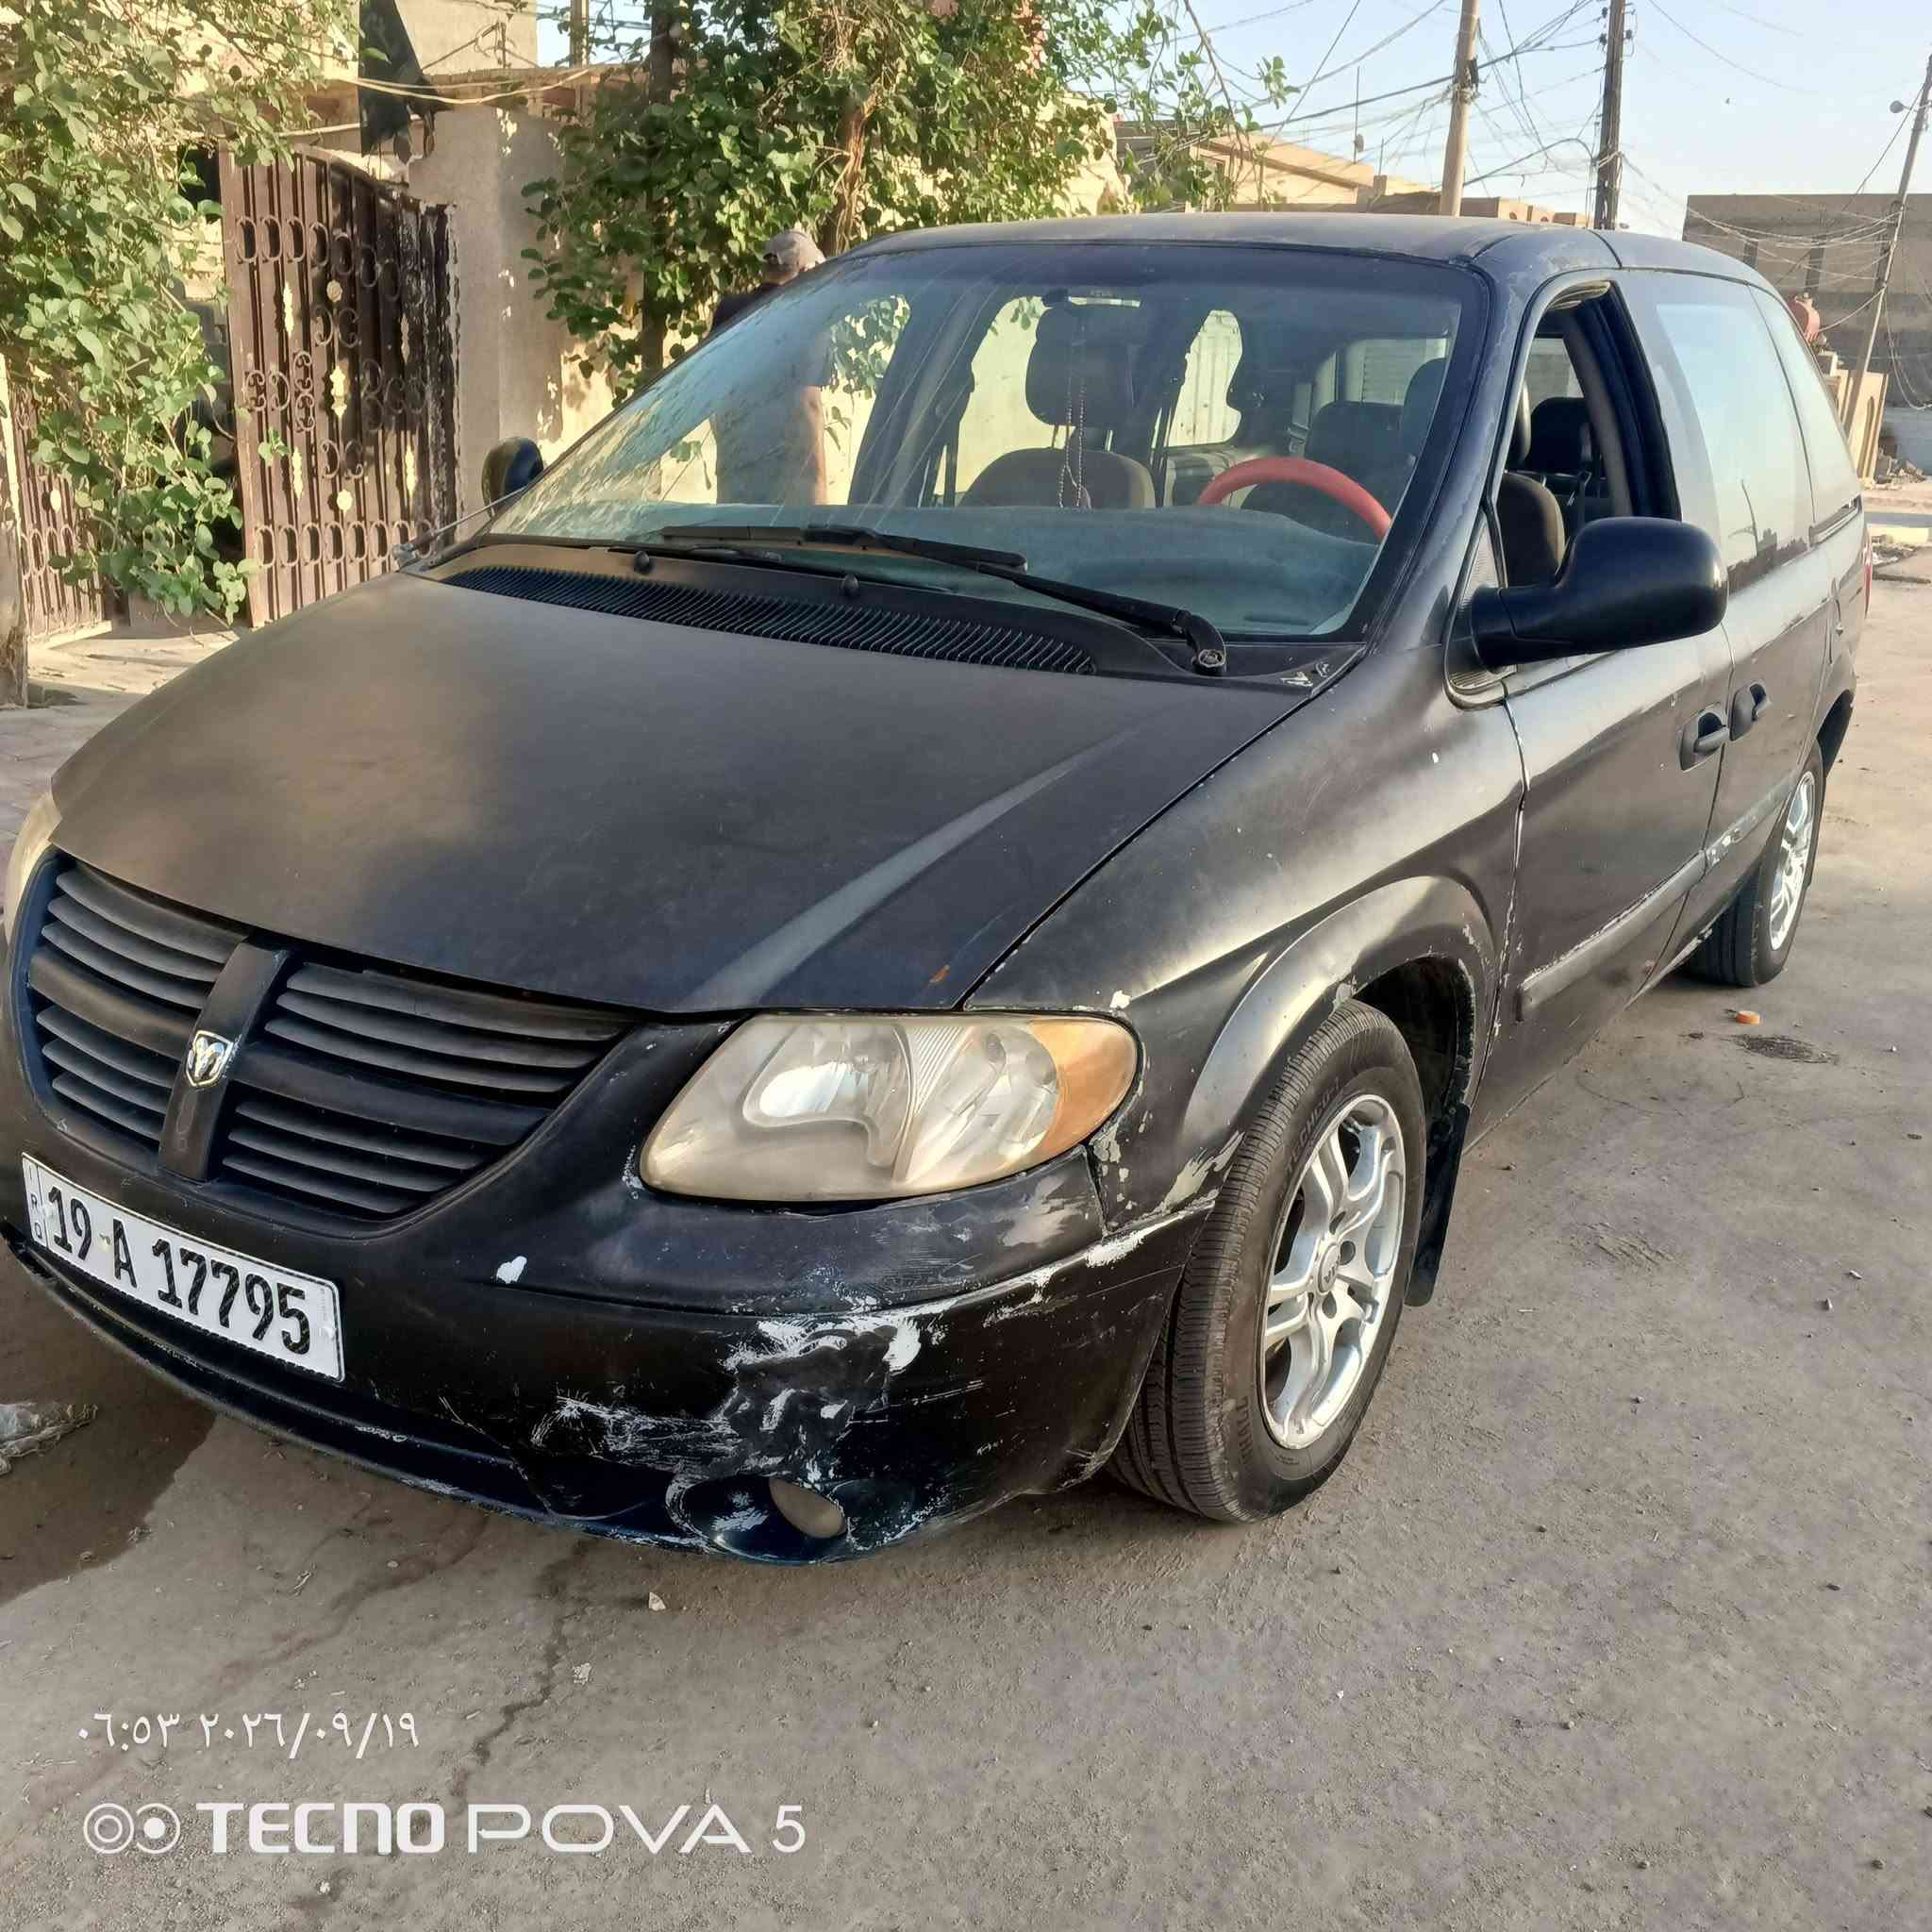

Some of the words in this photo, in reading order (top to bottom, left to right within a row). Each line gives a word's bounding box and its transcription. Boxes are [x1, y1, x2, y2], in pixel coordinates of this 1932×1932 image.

[48, 1186, 92, 1261] 19
[112, 1218, 138, 1289] A
[151, 1238, 311, 1355] 17795
